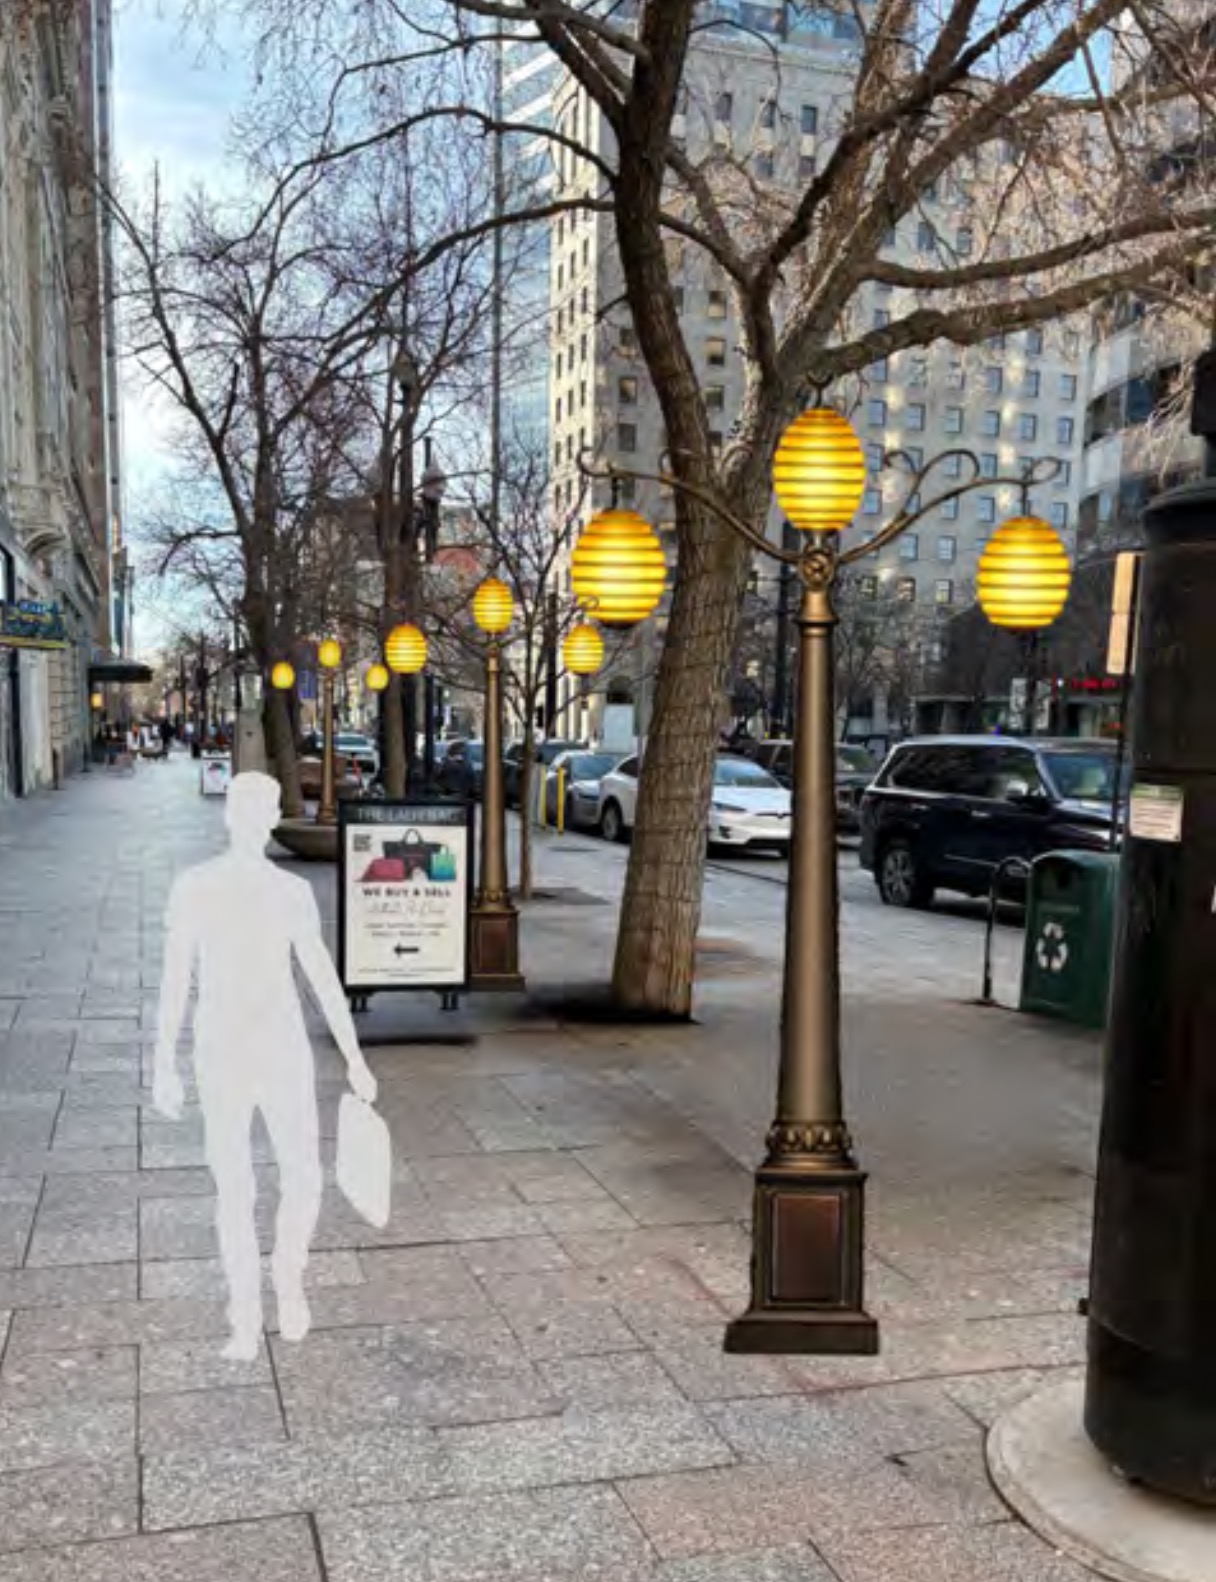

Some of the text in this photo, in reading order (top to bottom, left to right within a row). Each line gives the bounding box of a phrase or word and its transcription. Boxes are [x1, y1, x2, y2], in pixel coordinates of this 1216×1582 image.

[363, 887, 381, 897] WE
[385, 887, 409, 897] BUY
[424, 887, 451, 897] SELL
